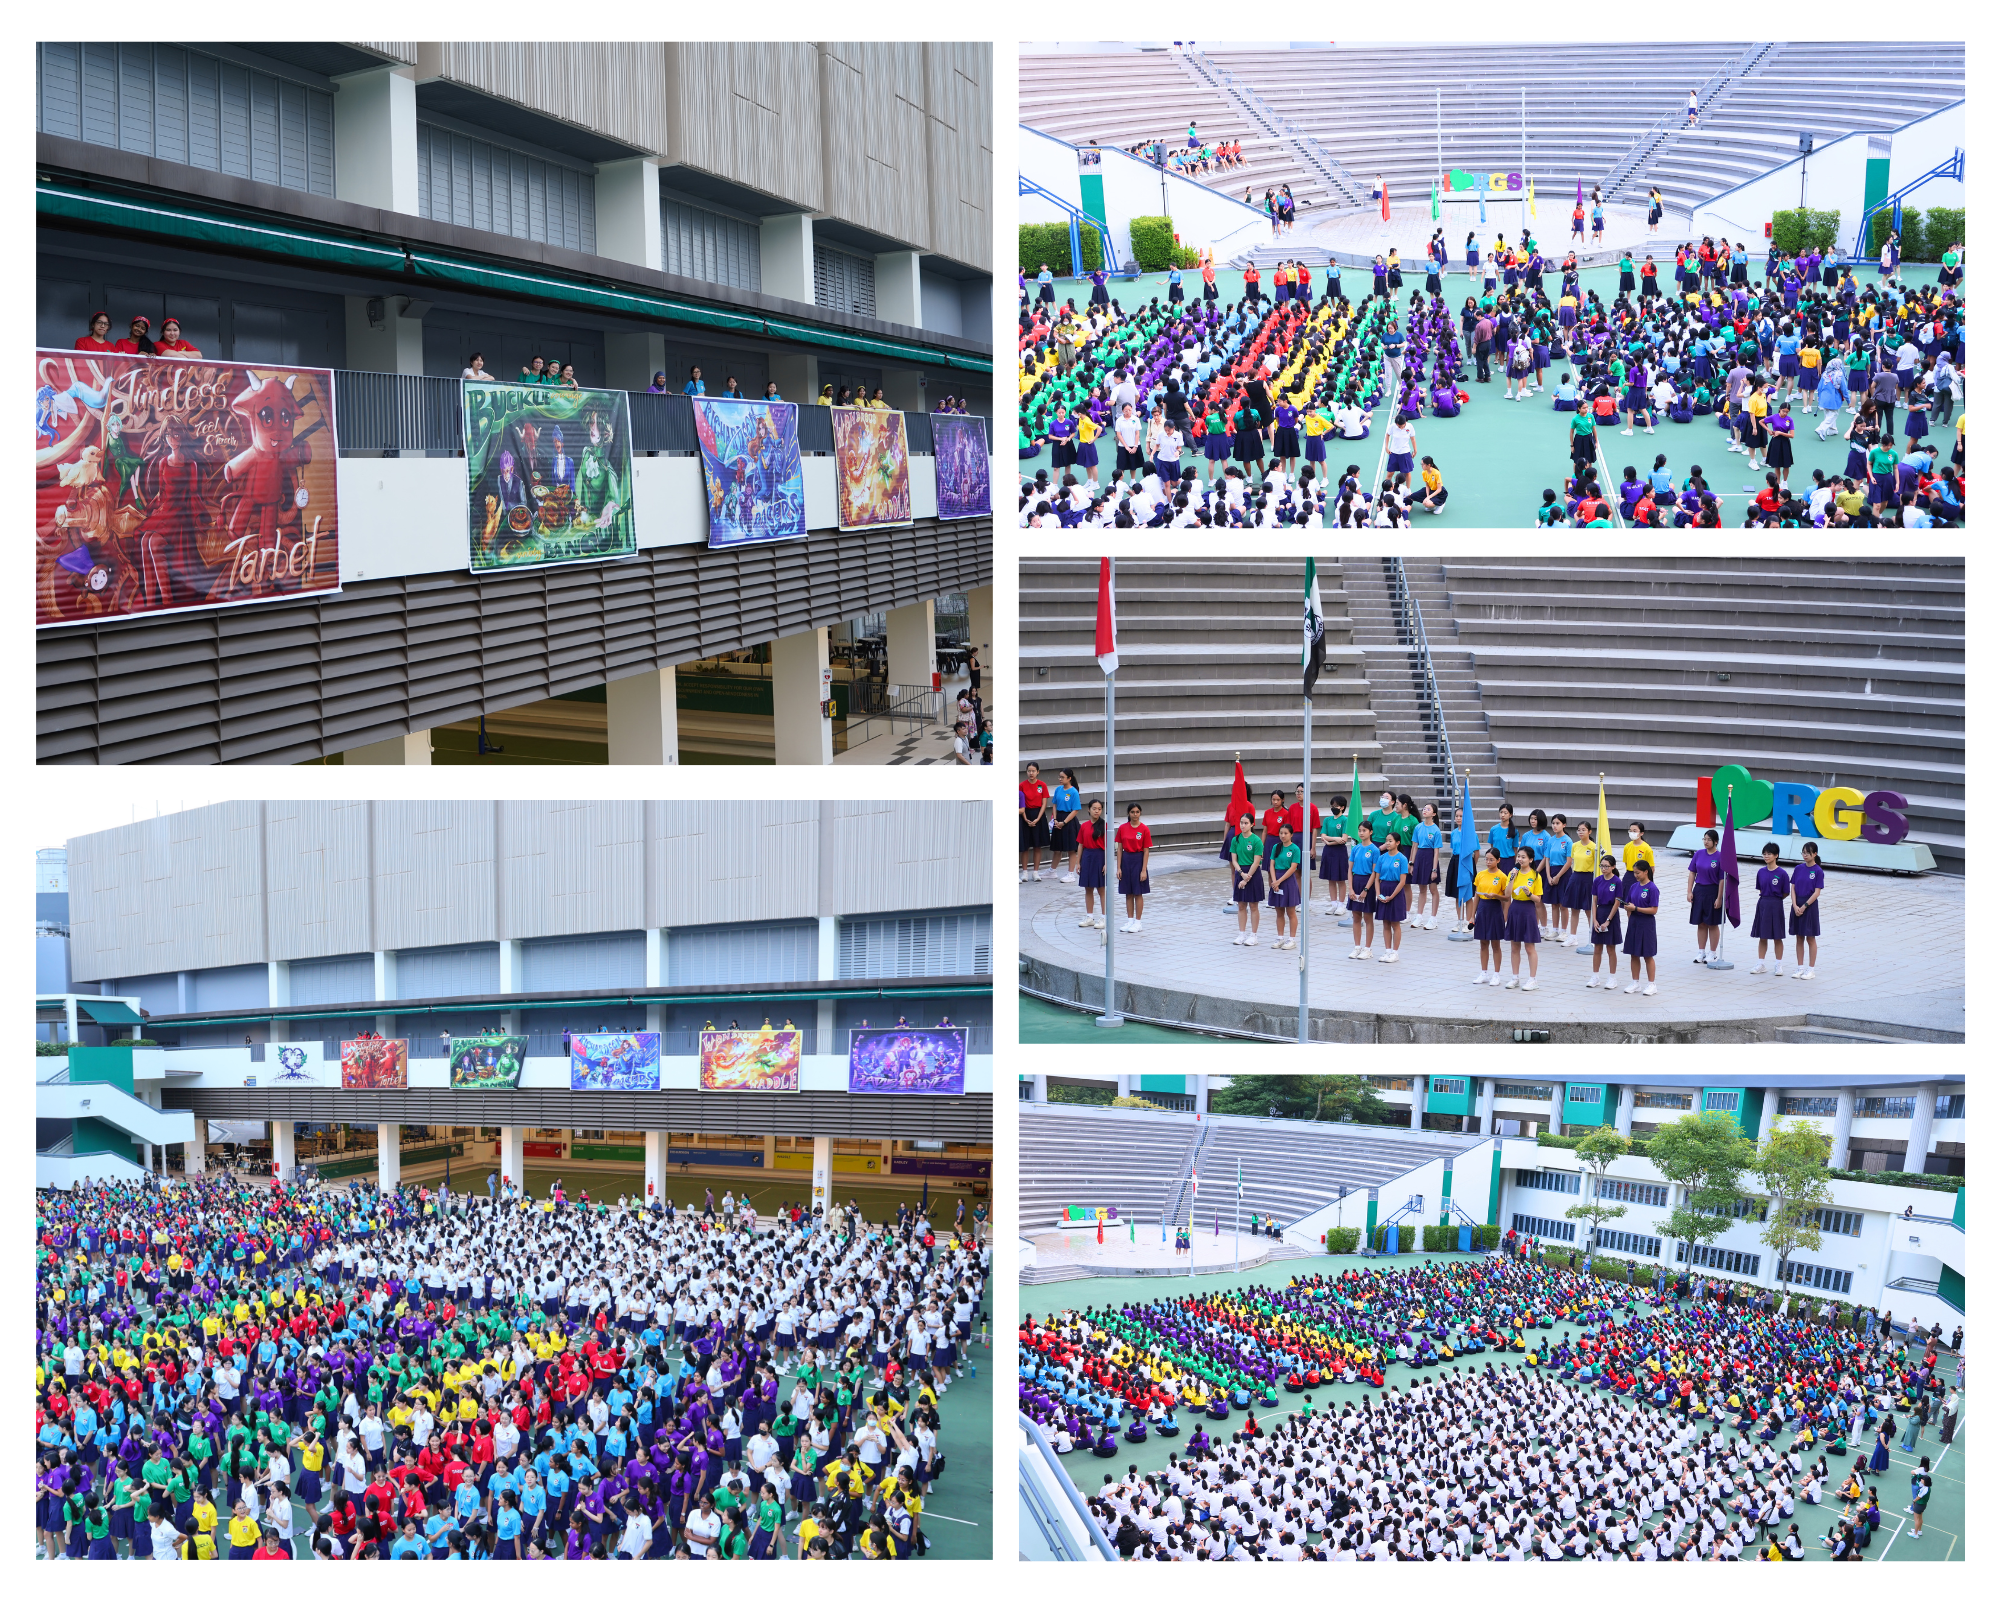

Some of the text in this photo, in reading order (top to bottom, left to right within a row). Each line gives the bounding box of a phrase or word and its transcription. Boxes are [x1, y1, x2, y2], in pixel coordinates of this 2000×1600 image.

[1473, 172, 1522, 191] RGS
[467, 389, 551, 457] BUCKLE
[223, 515, 330, 590] Tarbet
[1695, 776, 1910, 845] I RGS
[702, 1032, 760, 1052] WONDROUS
[748, 1067, 798, 1090] WADDLE
[1084, 1207, 1118, 1221] RGS
